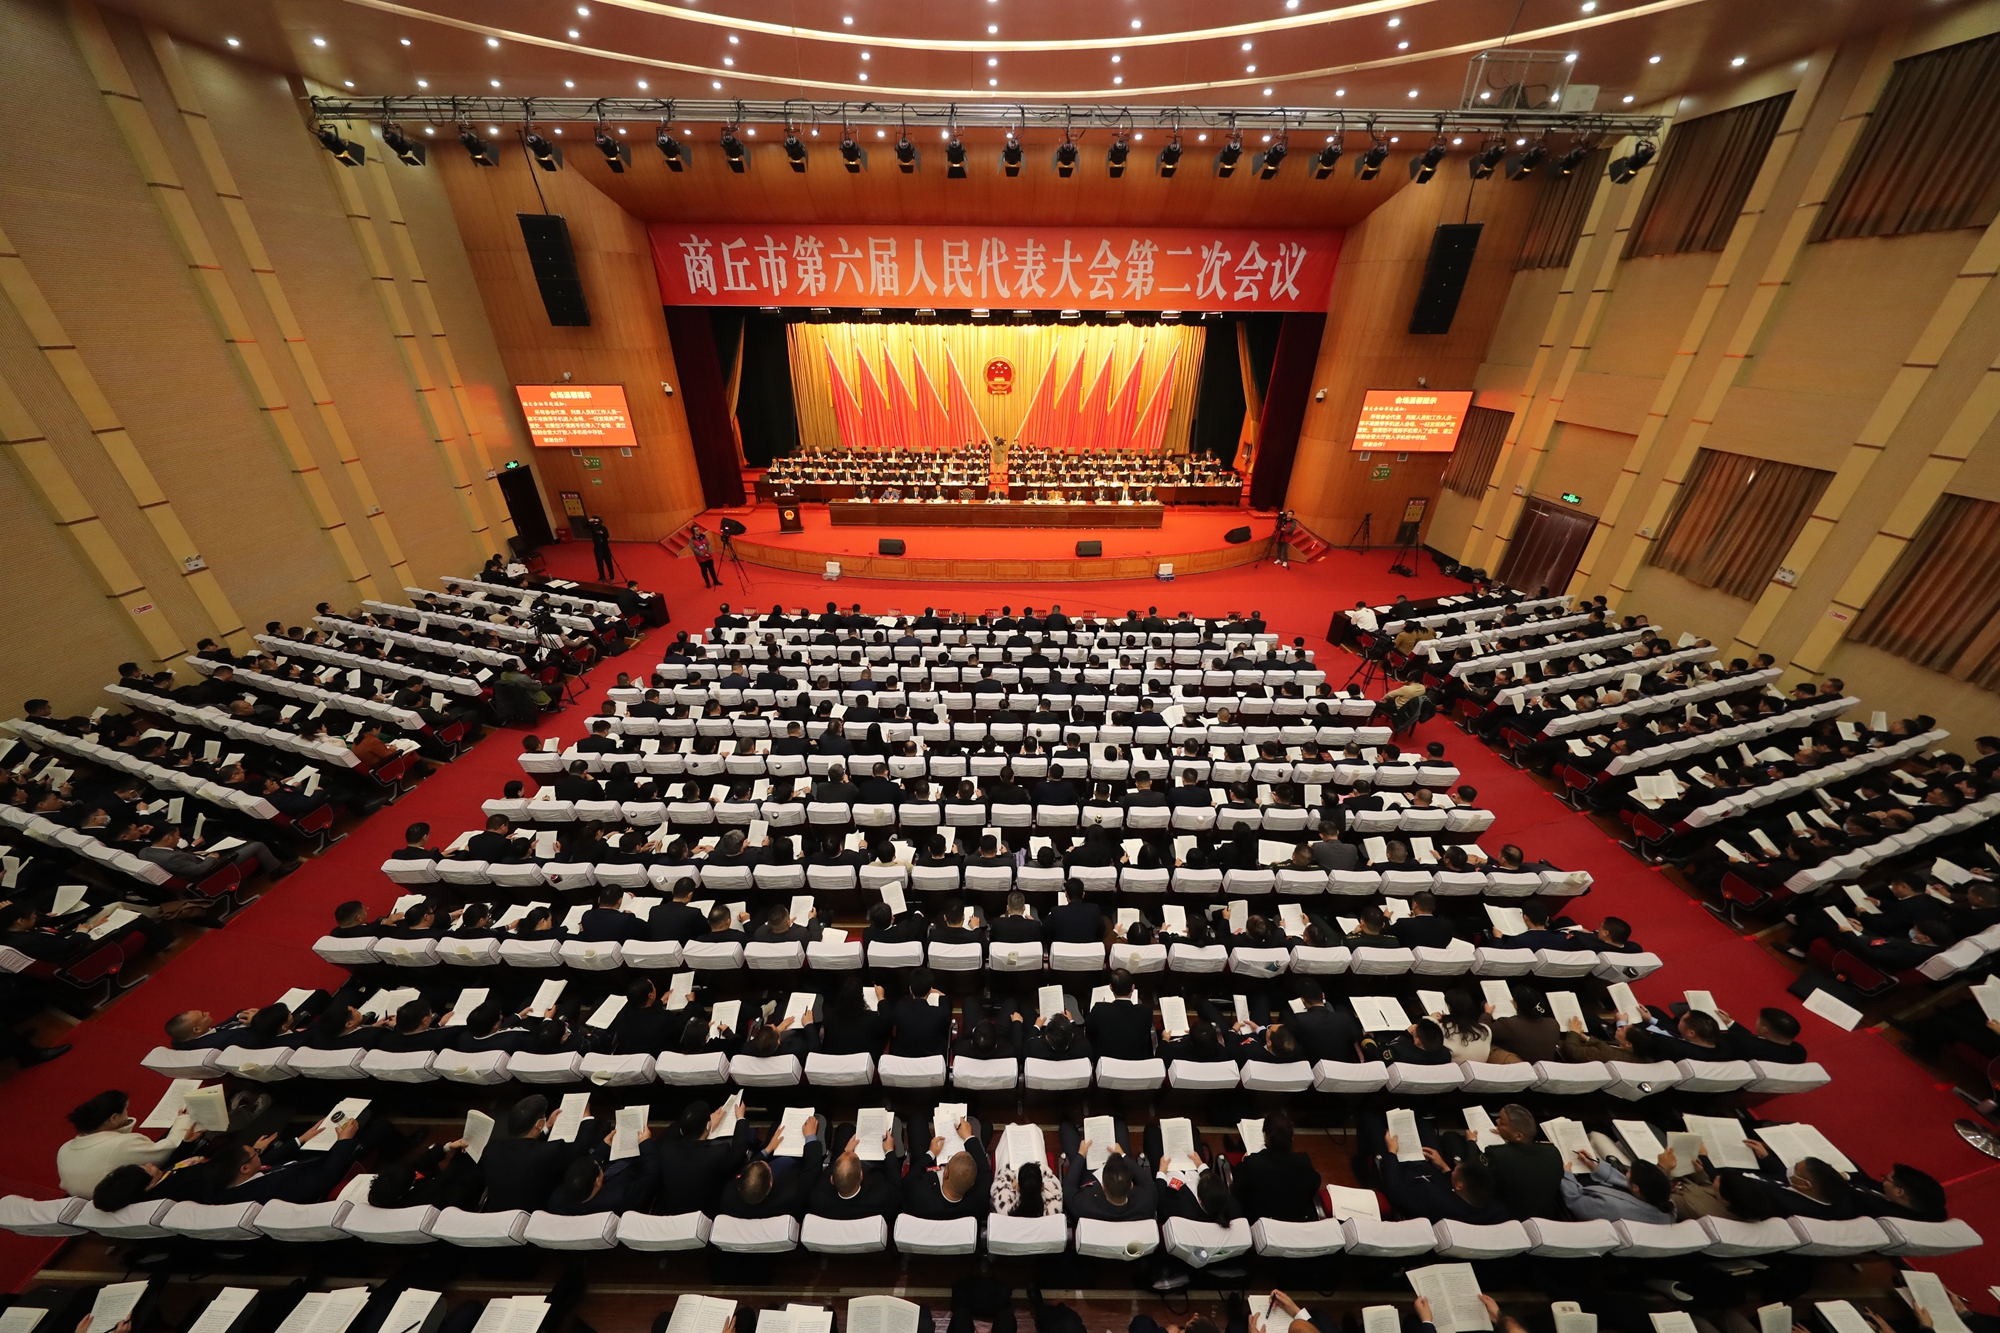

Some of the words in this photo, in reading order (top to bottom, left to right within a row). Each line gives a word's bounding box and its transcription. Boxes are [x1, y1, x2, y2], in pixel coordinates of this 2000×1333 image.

[679, 234, 1307, 300] 商丘市第六届人民代表大会第二次会议
